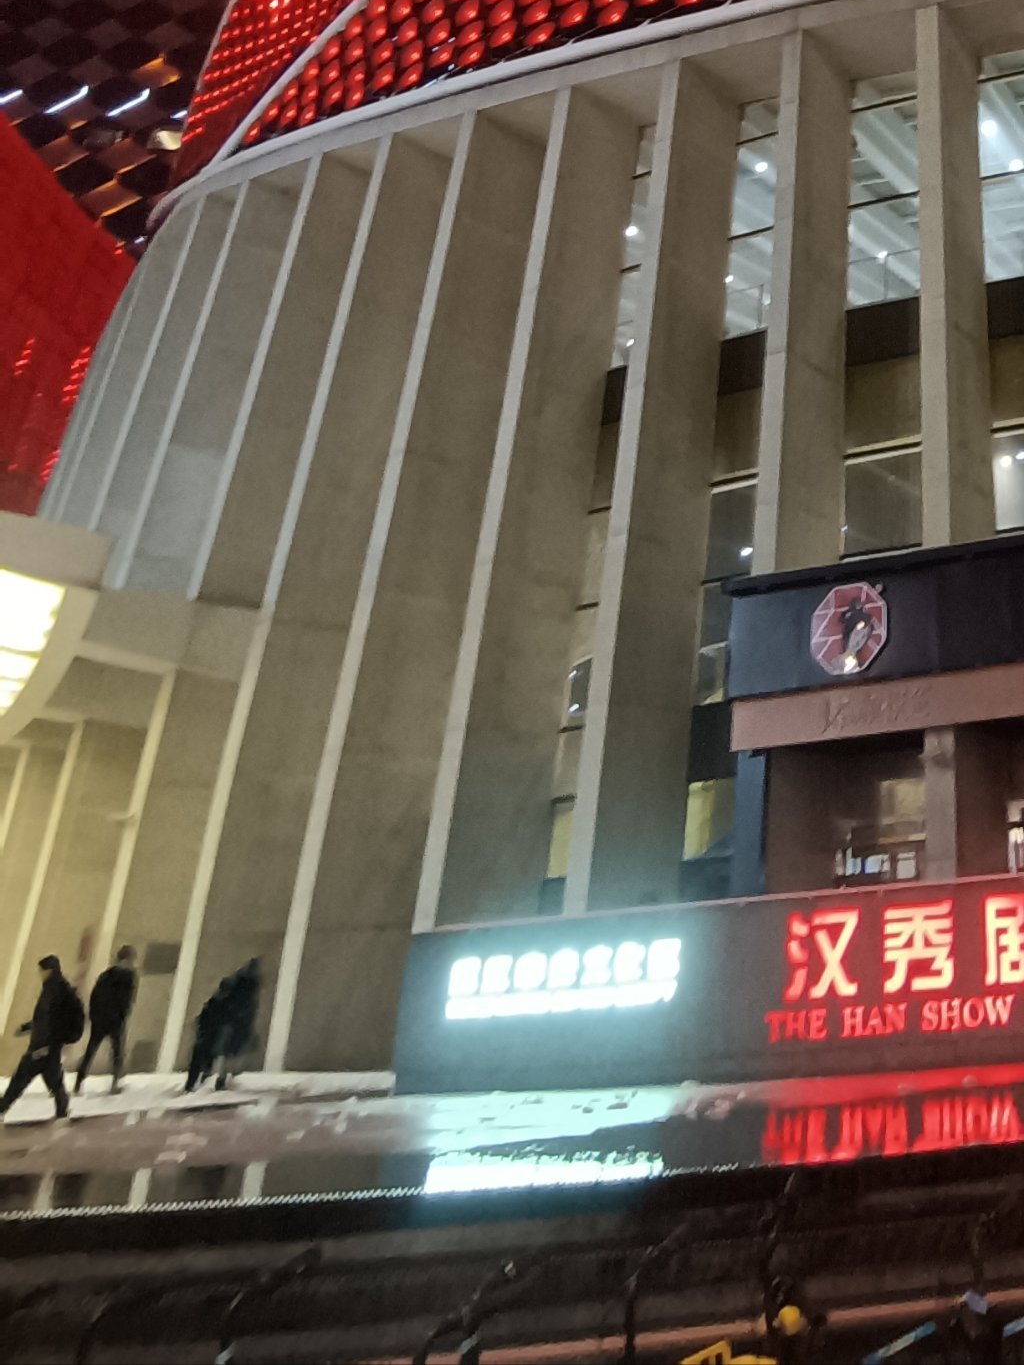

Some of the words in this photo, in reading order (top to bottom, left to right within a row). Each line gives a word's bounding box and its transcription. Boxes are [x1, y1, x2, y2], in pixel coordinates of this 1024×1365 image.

[765, 1009, 827, 1043] THE
[841, 1002, 907, 1038] HAN
[921, 994, 1015, 1033] SHOW
